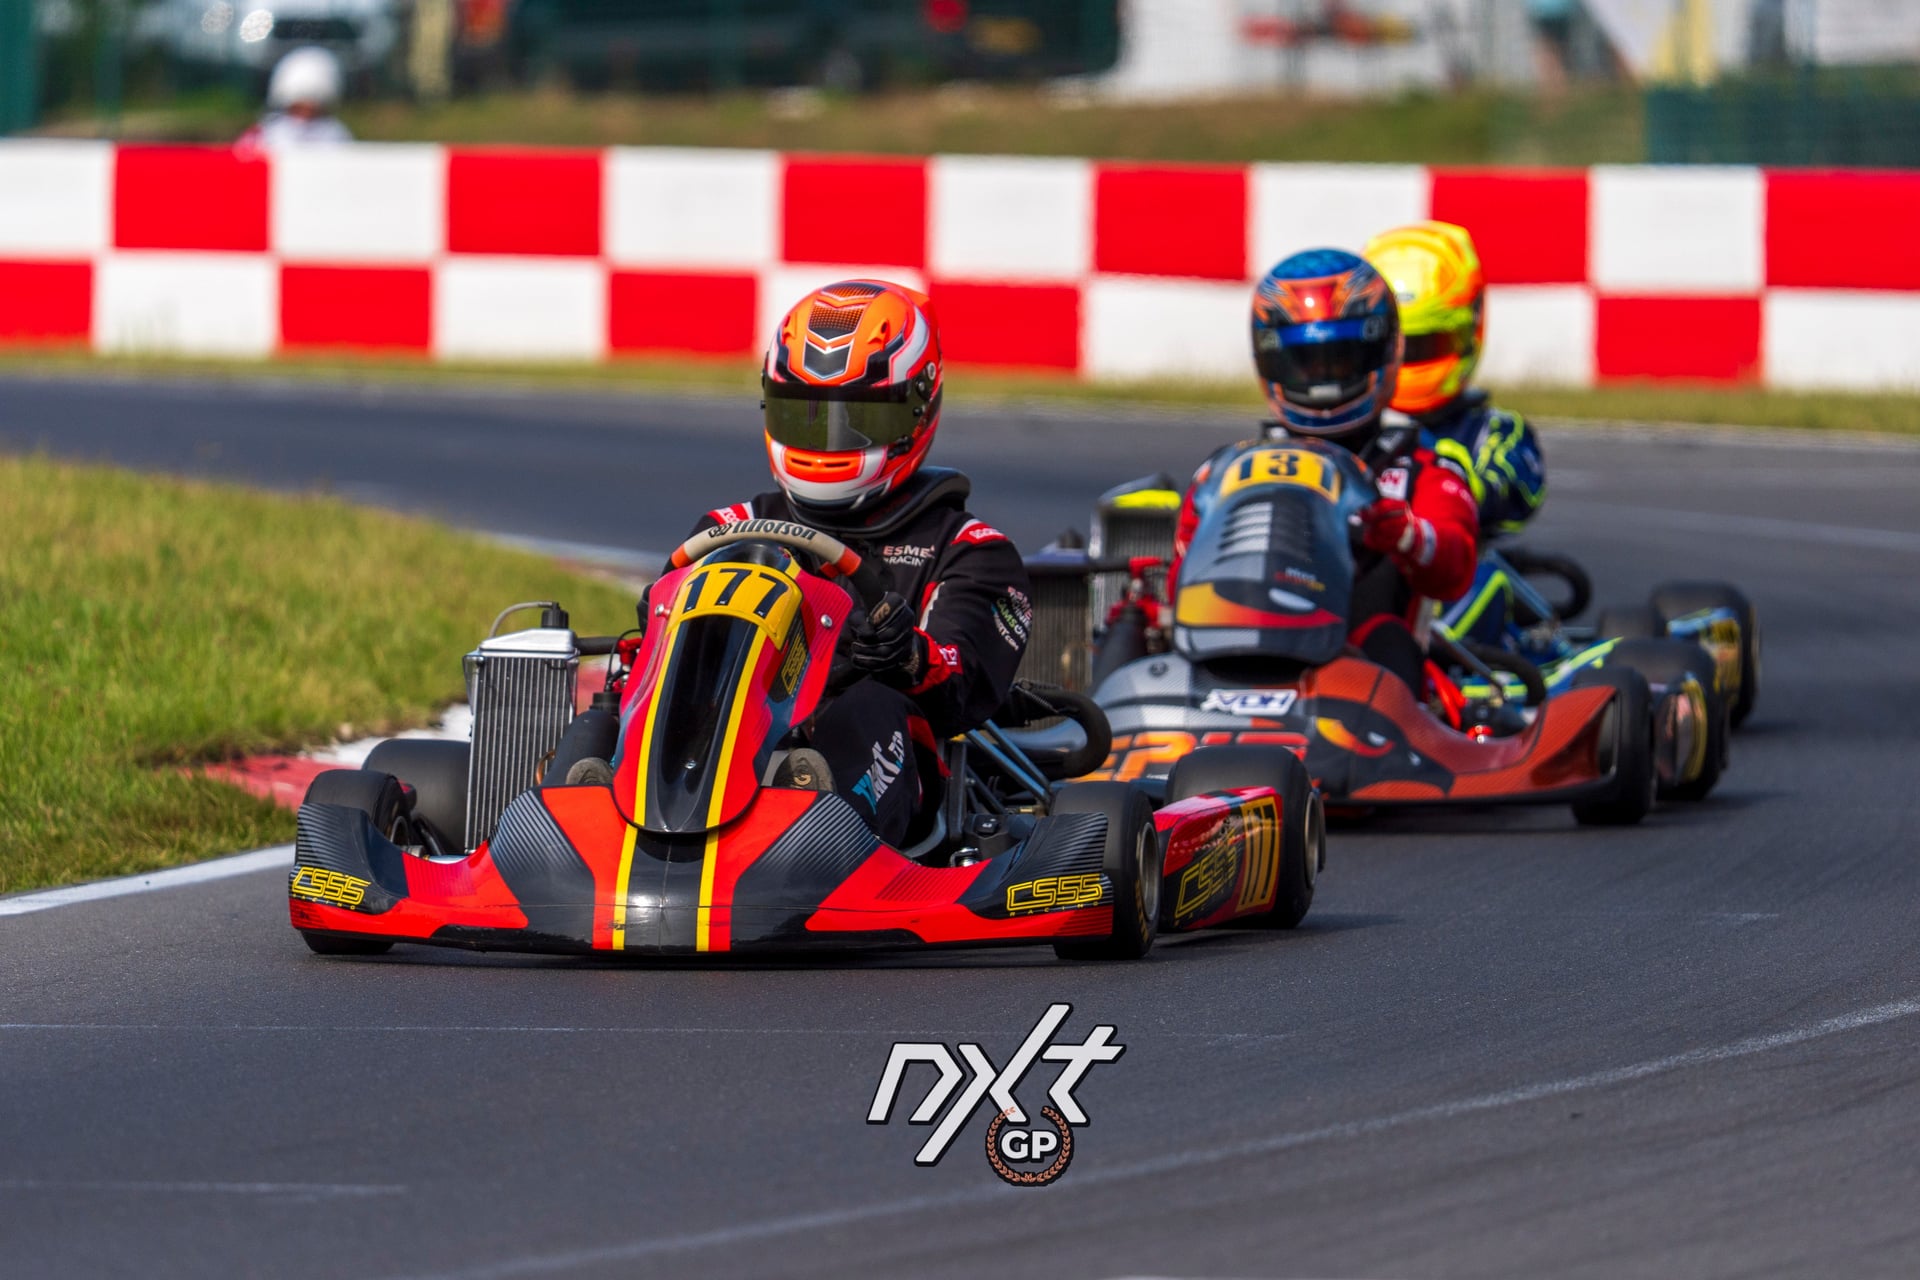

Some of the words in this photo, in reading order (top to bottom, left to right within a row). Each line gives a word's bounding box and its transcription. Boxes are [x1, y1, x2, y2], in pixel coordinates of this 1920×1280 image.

[889, 555, 925, 567] RACIN
[683, 568, 789, 619] 177
[1009, 900, 1099, 917] RACING
